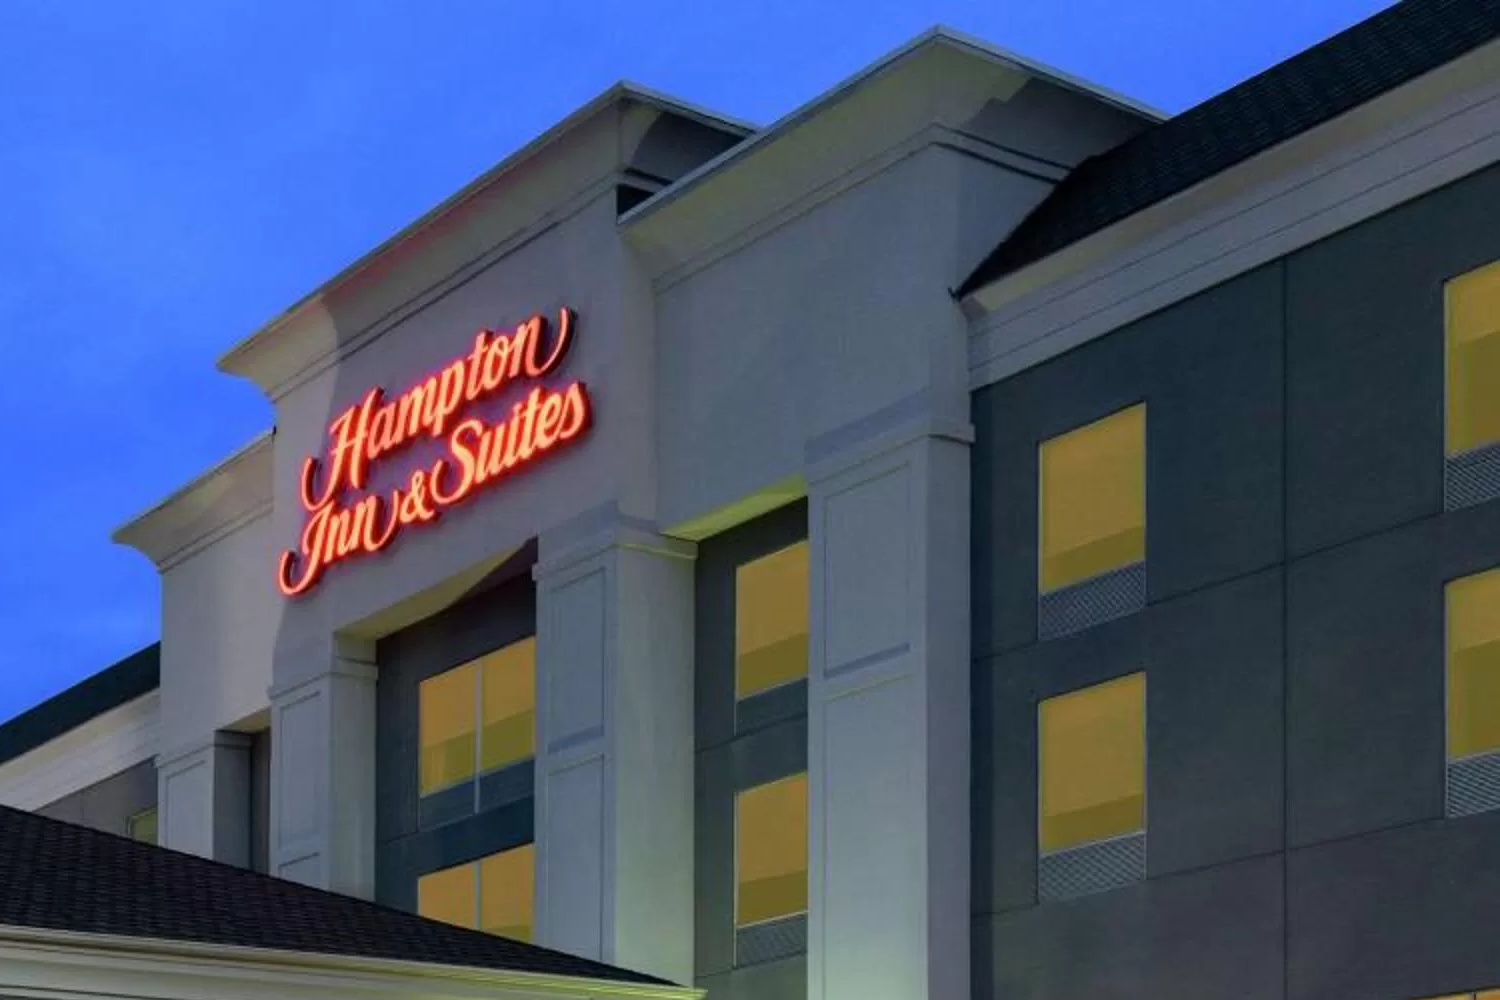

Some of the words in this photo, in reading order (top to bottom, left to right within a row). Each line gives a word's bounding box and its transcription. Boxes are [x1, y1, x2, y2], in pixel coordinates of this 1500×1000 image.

[278, 489, 399, 595] Inn
[400, 470, 437, 524] &
[430, 379, 588, 505] Suites
[301, 305, 573, 513] Hampton
